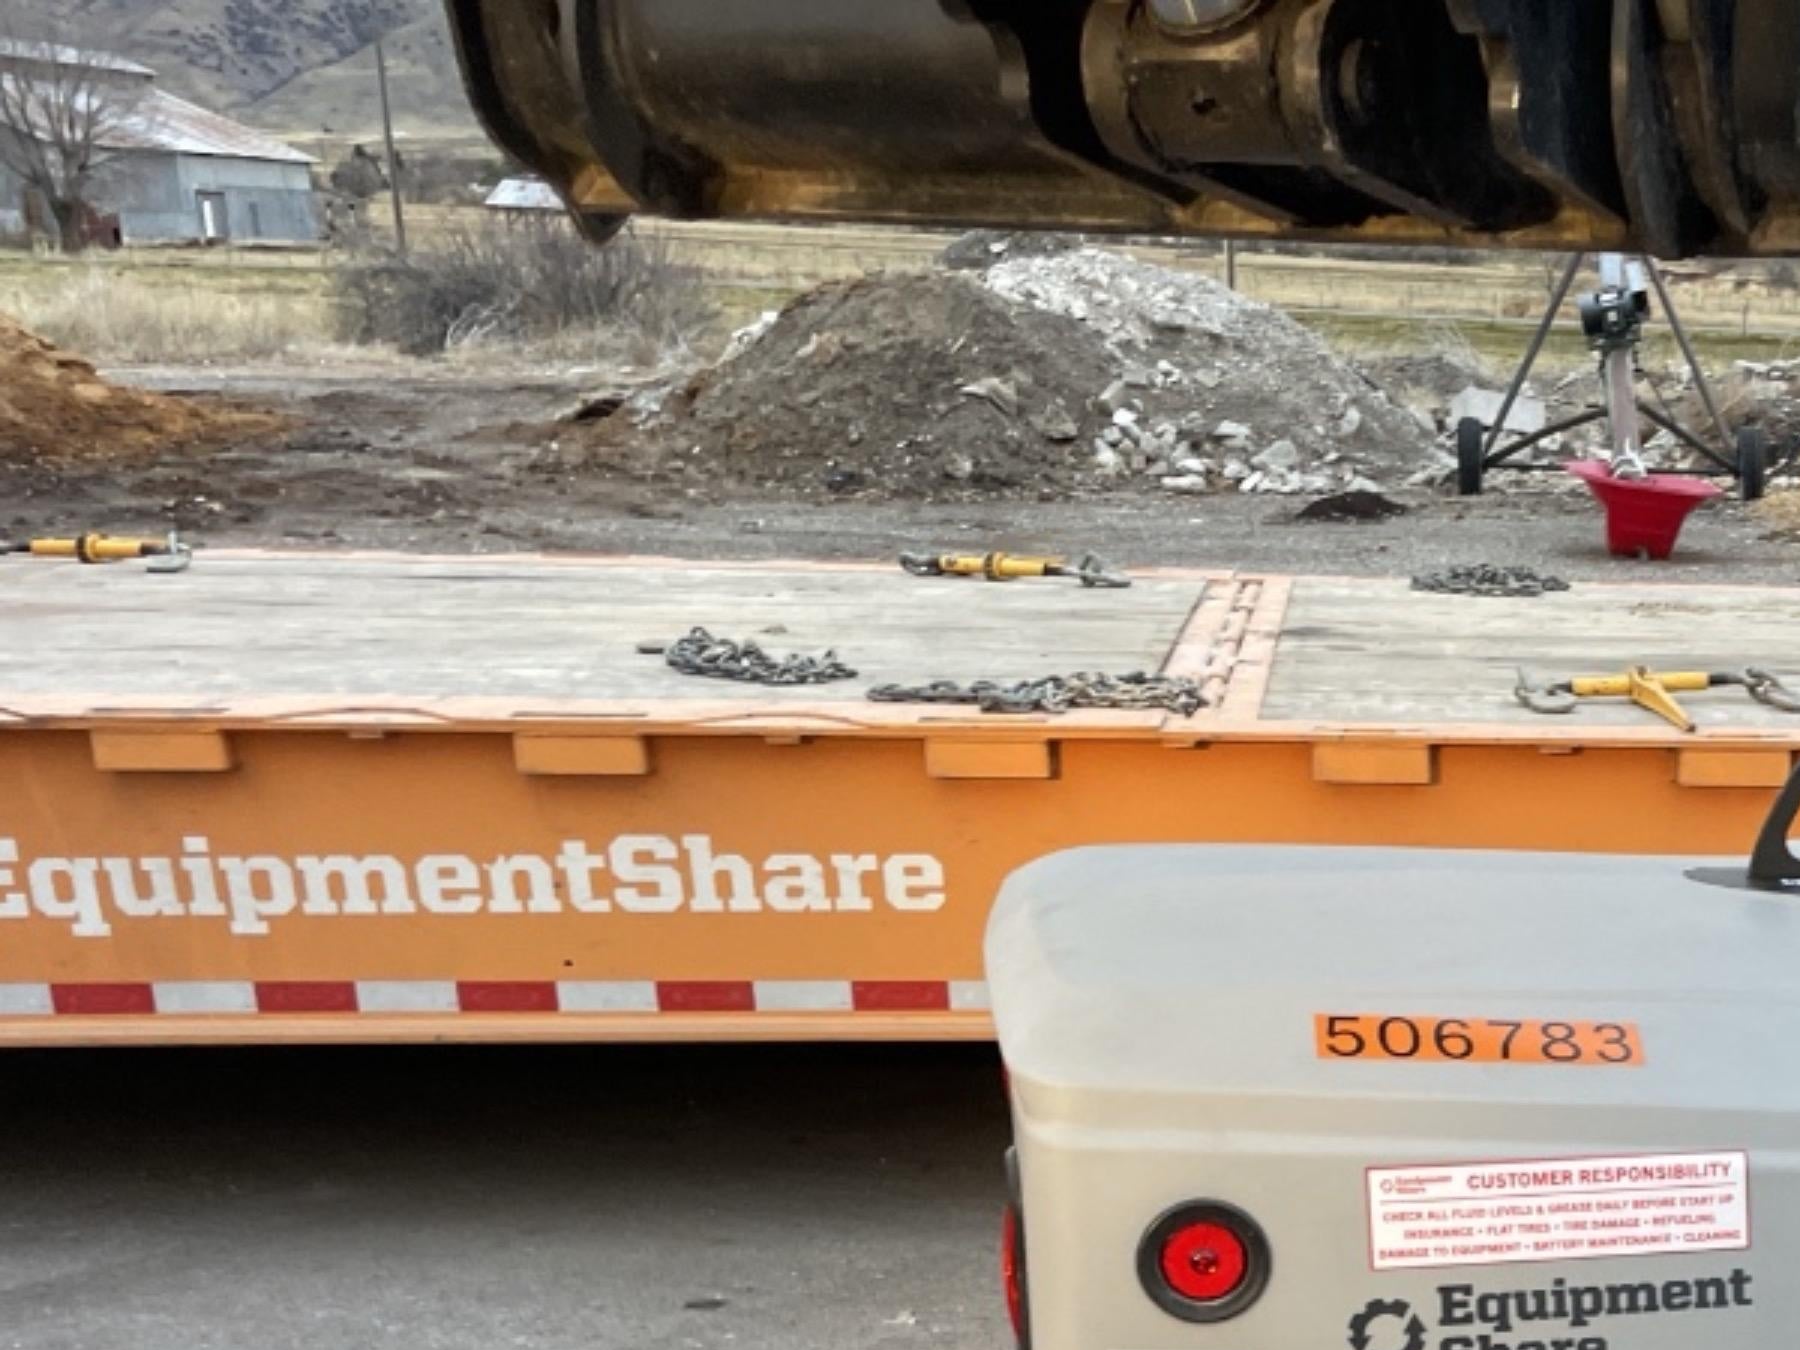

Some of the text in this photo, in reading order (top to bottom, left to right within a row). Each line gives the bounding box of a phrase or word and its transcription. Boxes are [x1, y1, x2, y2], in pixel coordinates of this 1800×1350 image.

[1325, 1015, 1634, 1064] 506783
[1466, 1169, 1573, 1190] CUSTOMER
[1578, 1161, 1732, 1185] RESPONSIBILITY
[1427, 1208, 1449, 1221] ALL
[1487, 1223, 1514, 1237] FLAT
[1591, 1217, 1641, 1230] DAMAGE
[1433, 1246, 1449, 1258] TO
[1451, 1241, 1523, 1257] EQUIPMENT
[1437, 1268, 1753, 1333] Equipment
